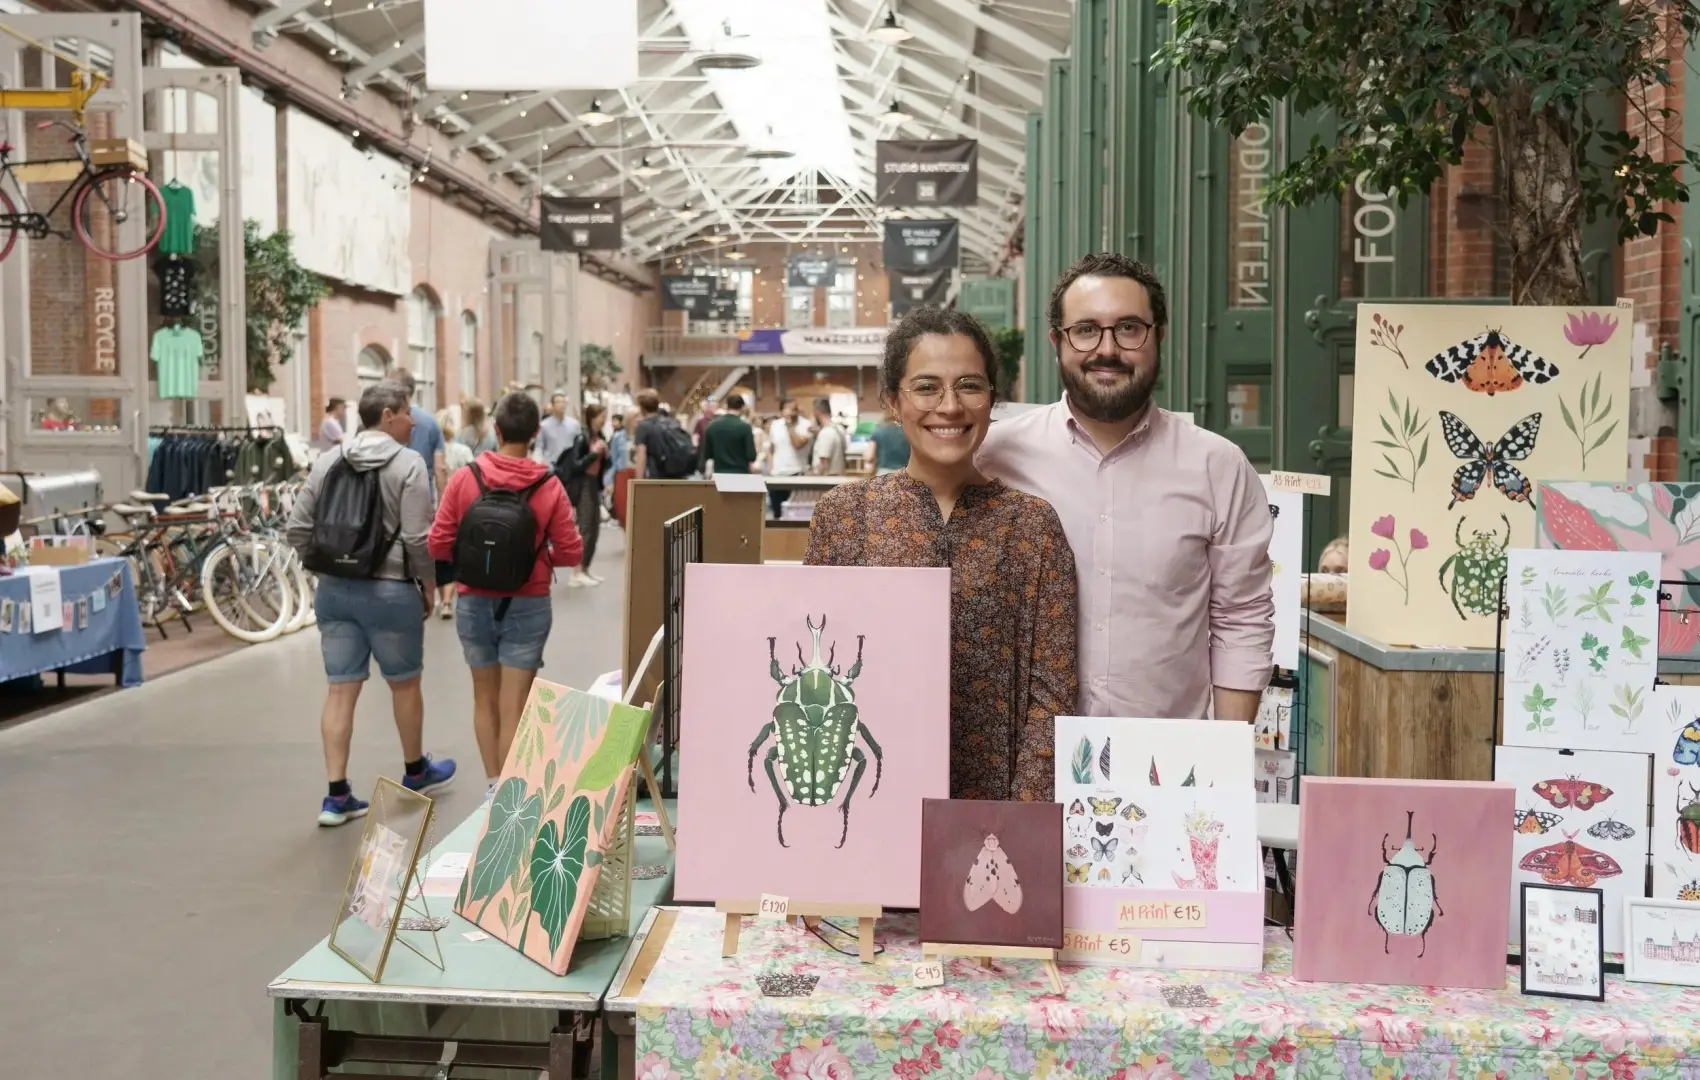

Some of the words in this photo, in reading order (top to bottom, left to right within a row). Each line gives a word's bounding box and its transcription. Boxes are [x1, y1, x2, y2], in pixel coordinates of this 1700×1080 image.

[95, 287, 116, 372] RECYCLE
[803, 334, 848, 345] MAKER
[1284, 474, 1302, 488] Print
[761, 898, 786, 914] €120
[1119, 904, 1135, 921] A4
[1138, 902, 1172, 920] Print
[1173, 905, 1201, 921] €15
[1063, 933, 1072, 947] 5
[1074, 933, 1103, 951] Print
[1108, 938, 1131, 954] €5
[914, 966, 941, 980] €45
